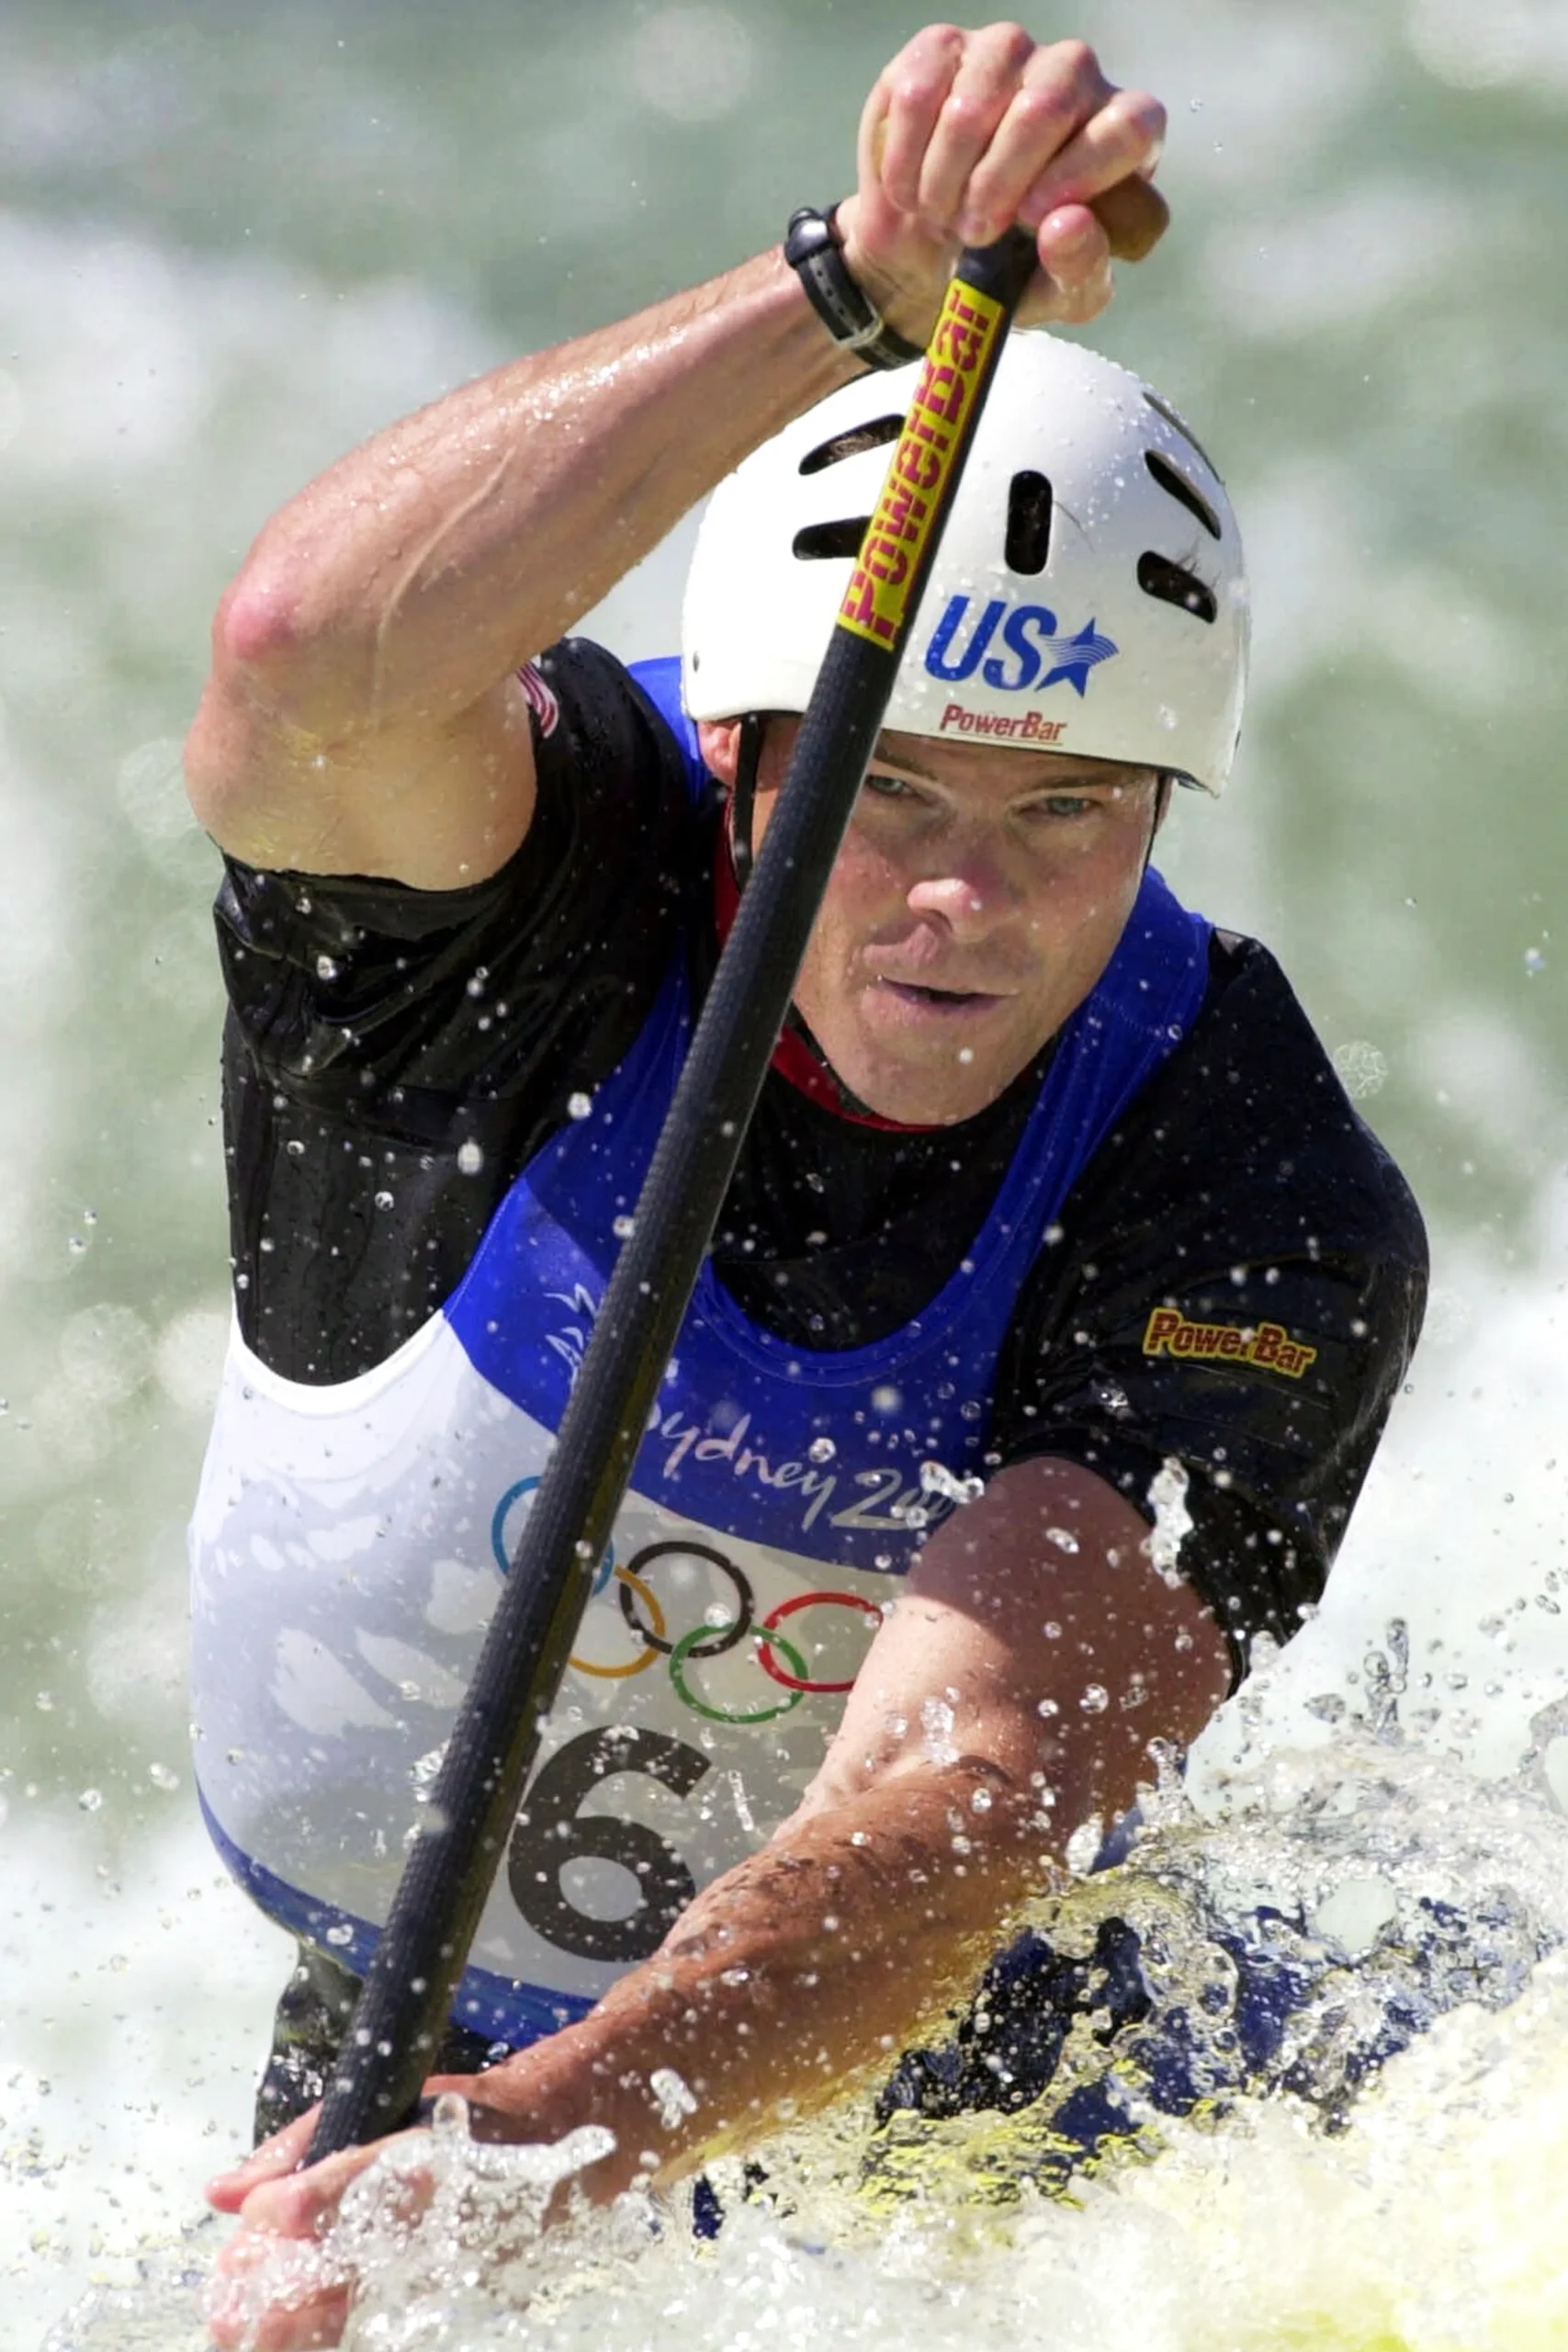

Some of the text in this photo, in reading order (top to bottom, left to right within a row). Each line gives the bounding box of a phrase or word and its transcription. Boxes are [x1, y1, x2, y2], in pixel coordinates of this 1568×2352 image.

[939, 703, 1068, 741] PowerBar
[647, 1402, 837, 1532] ydney
[508, 1724, 712, 1962] 6
